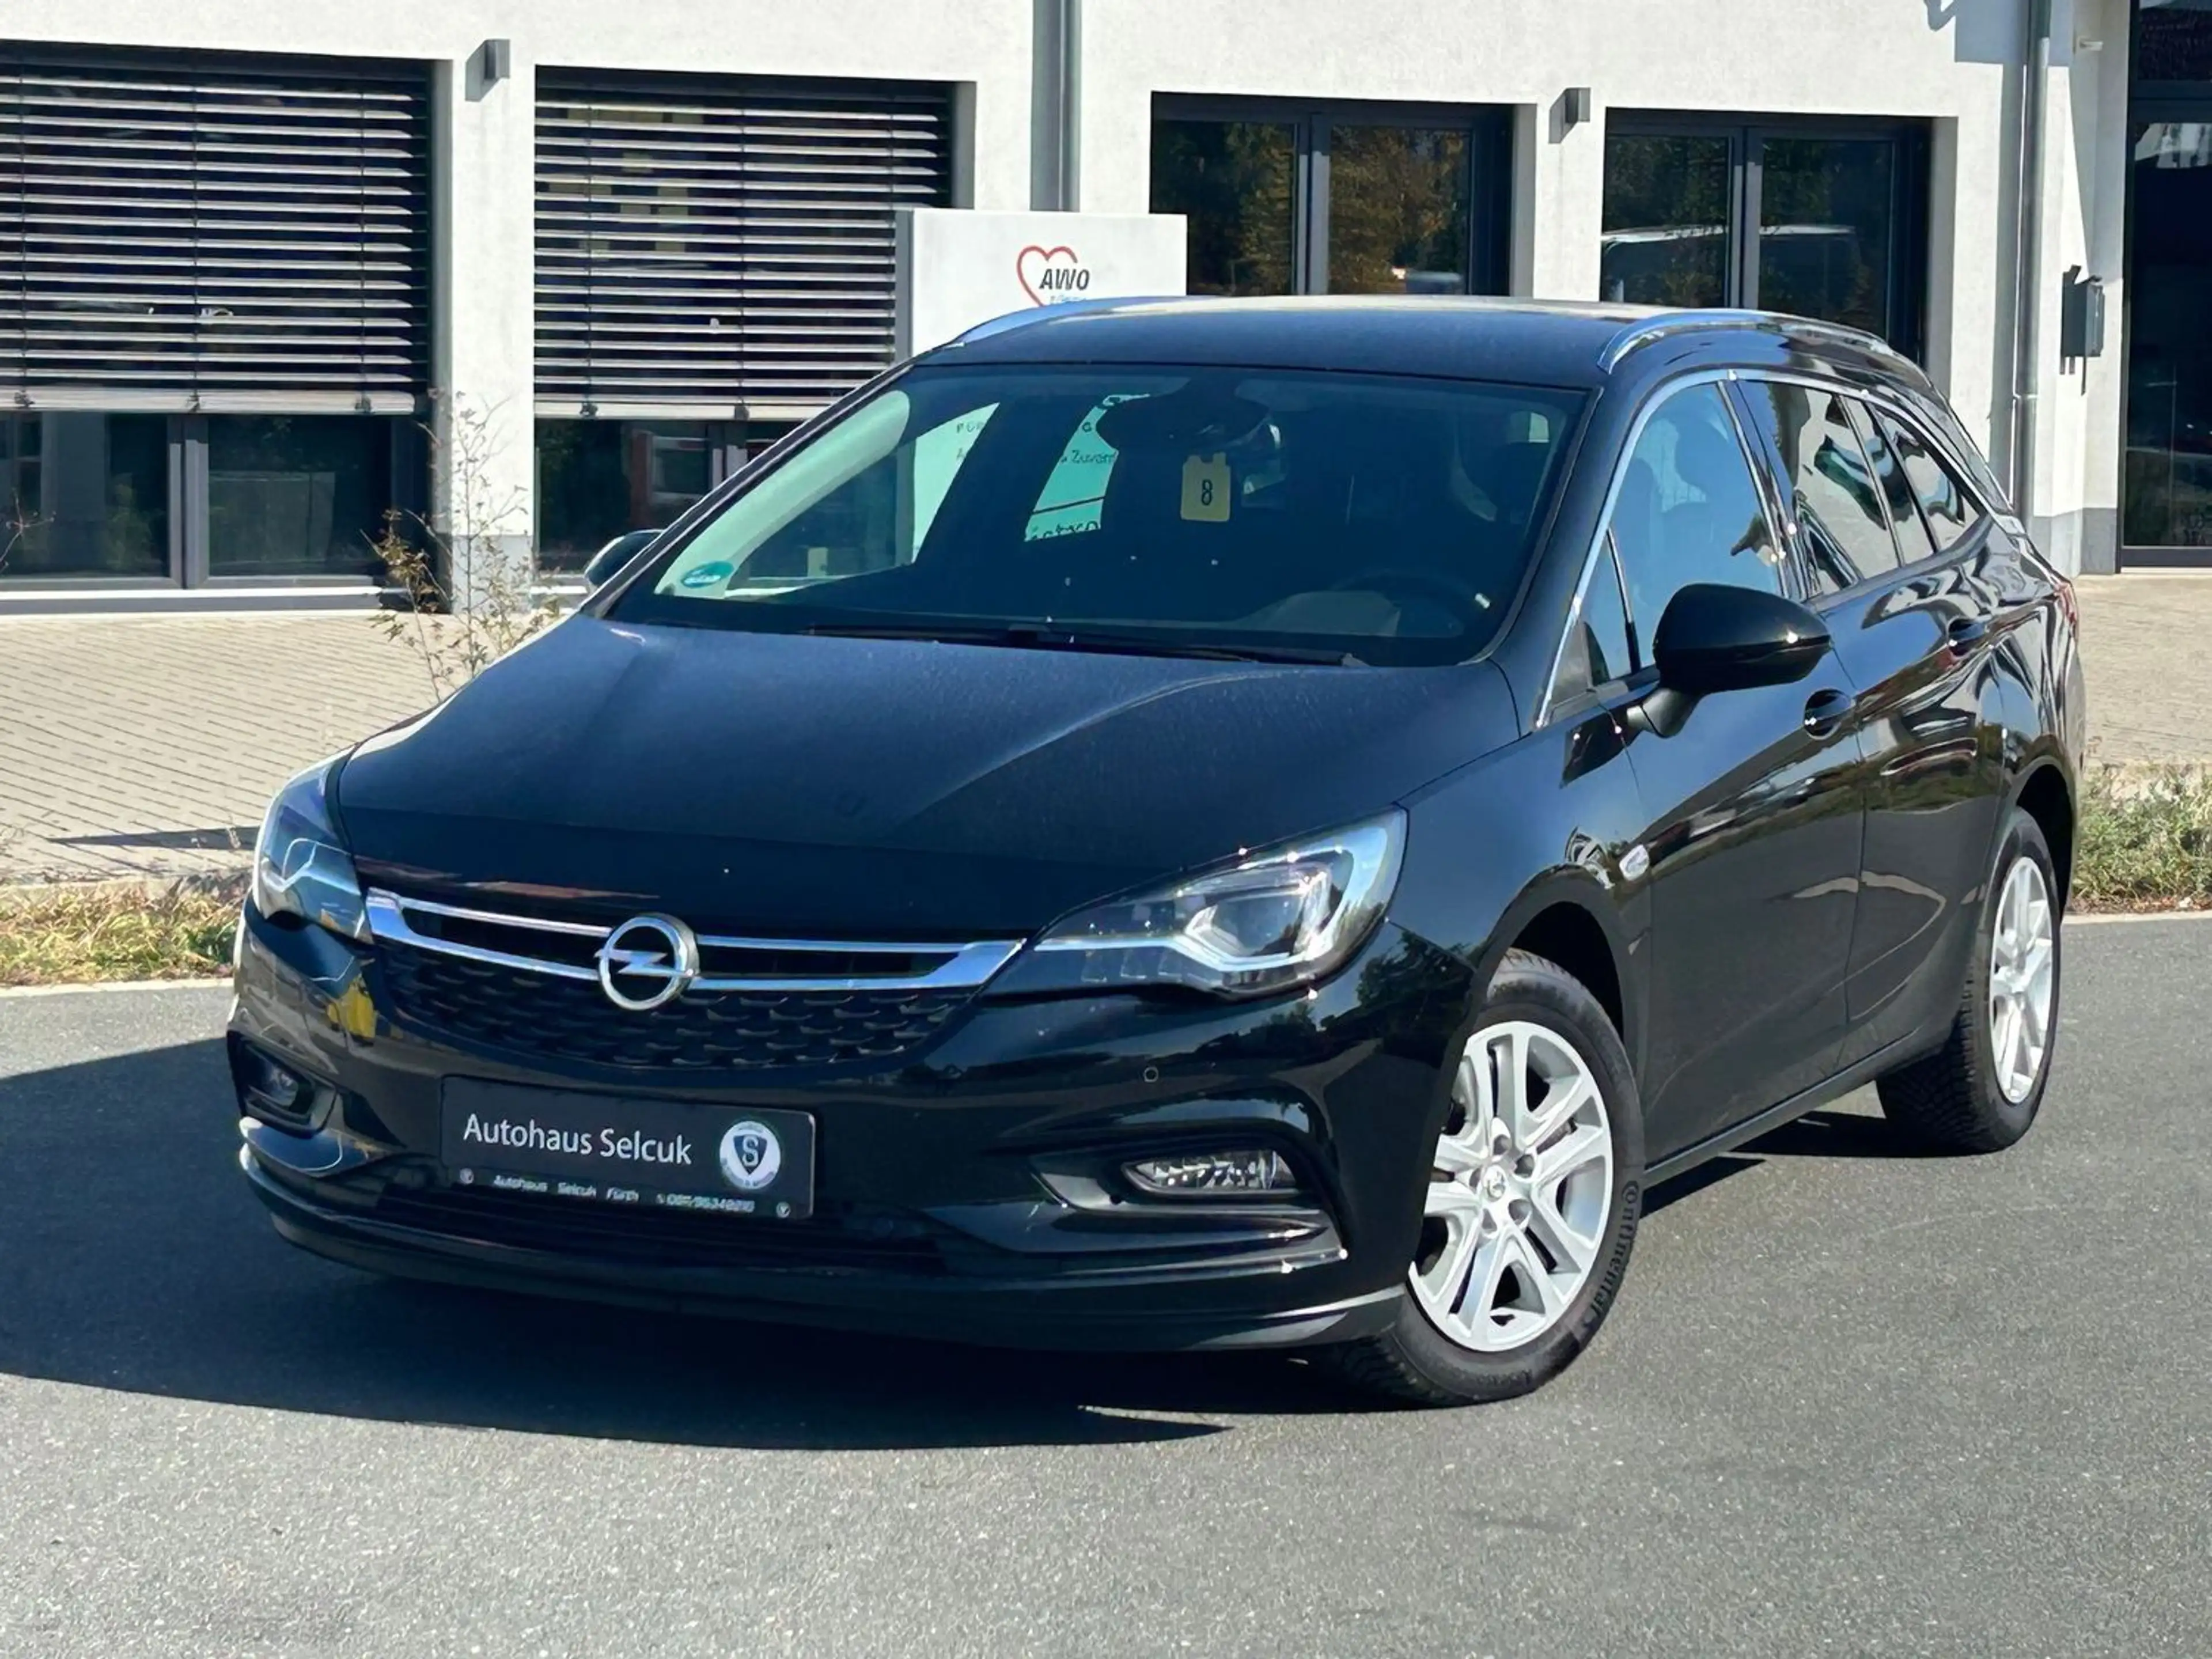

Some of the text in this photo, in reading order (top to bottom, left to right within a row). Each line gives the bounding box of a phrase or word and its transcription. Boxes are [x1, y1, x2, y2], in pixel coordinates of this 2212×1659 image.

[1039, 268, 1090, 291] AWO
[1201, 479, 1213, 506] 8
[464, 1113, 692, 1165] Autohaus Selcuk
[1590, 1181, 1639, 1315] Continental
